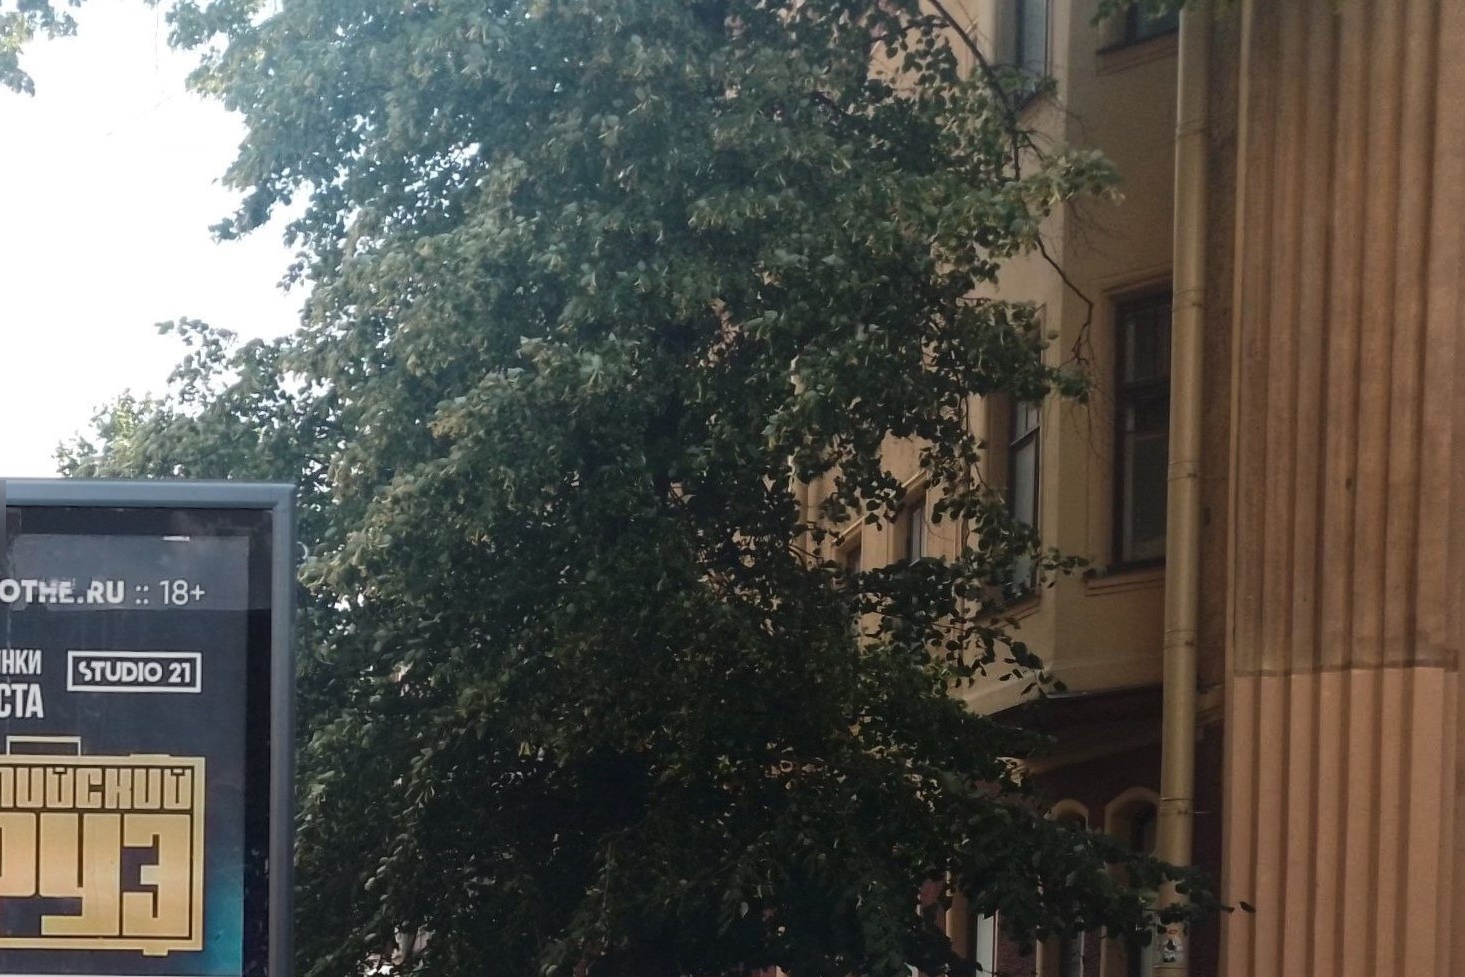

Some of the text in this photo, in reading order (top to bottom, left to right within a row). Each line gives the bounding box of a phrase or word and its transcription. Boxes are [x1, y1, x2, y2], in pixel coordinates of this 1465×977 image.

[159, 579, 206, 606] 18+
[78, 661, 191, 684] STUDIO 21
